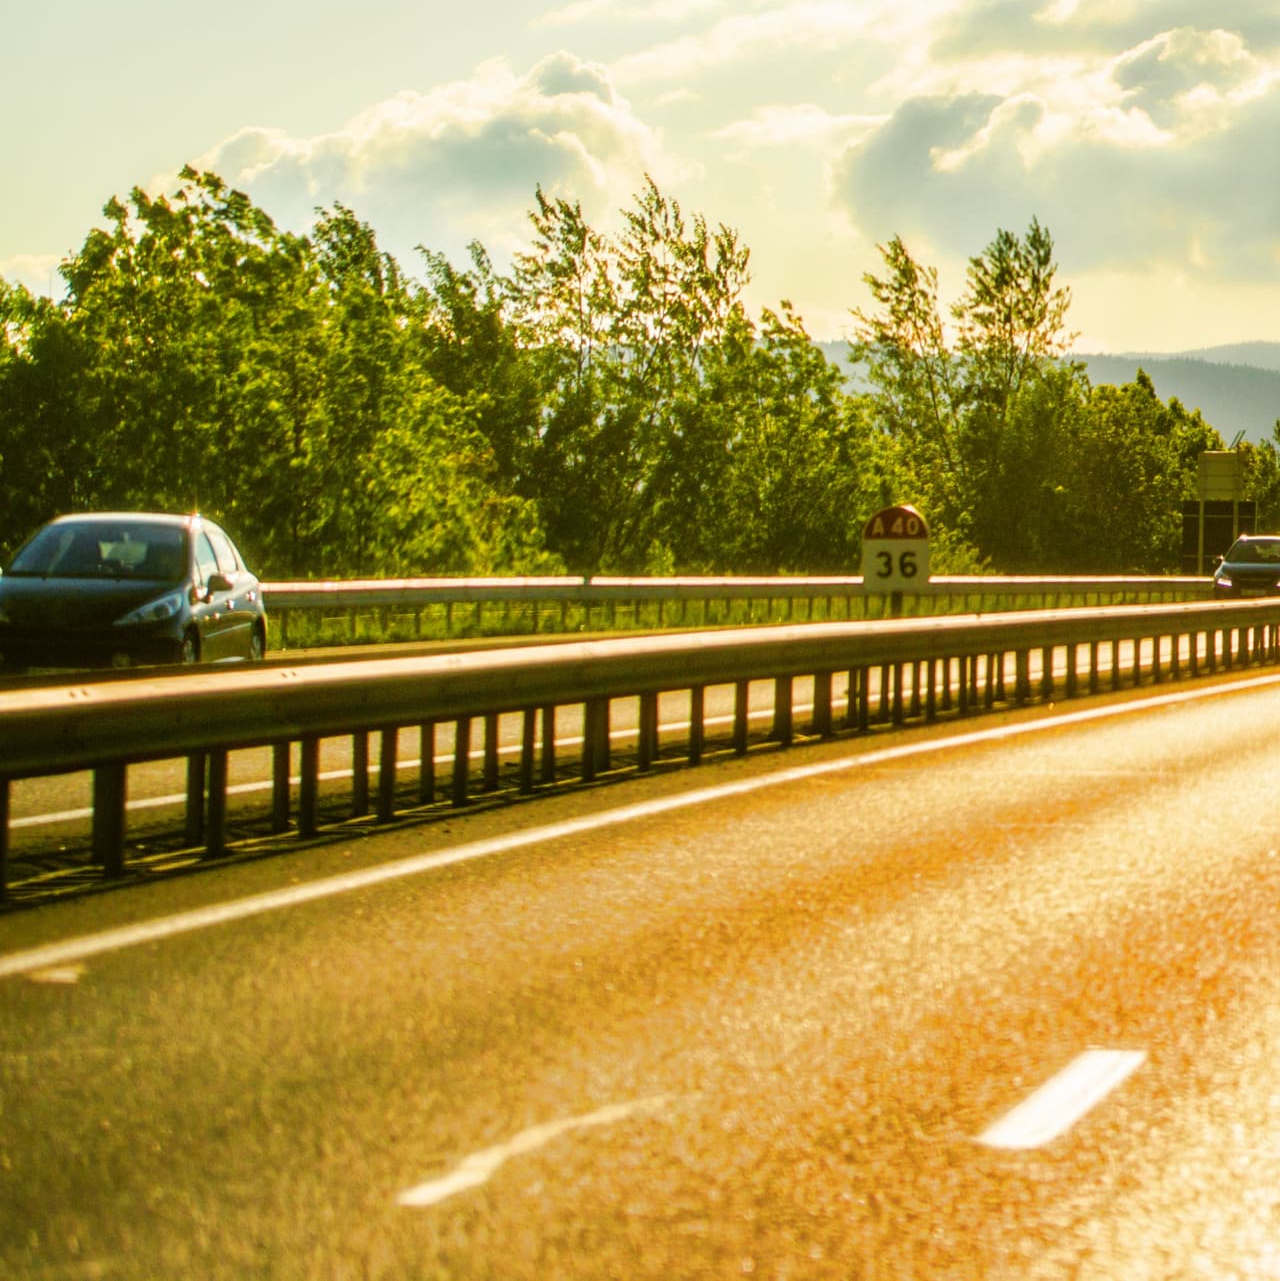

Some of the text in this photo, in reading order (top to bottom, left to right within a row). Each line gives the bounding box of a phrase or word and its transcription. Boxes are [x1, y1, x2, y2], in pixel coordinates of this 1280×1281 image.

[872, 517, 919, 535] A 40
[876, 551, 917, 578] 36
